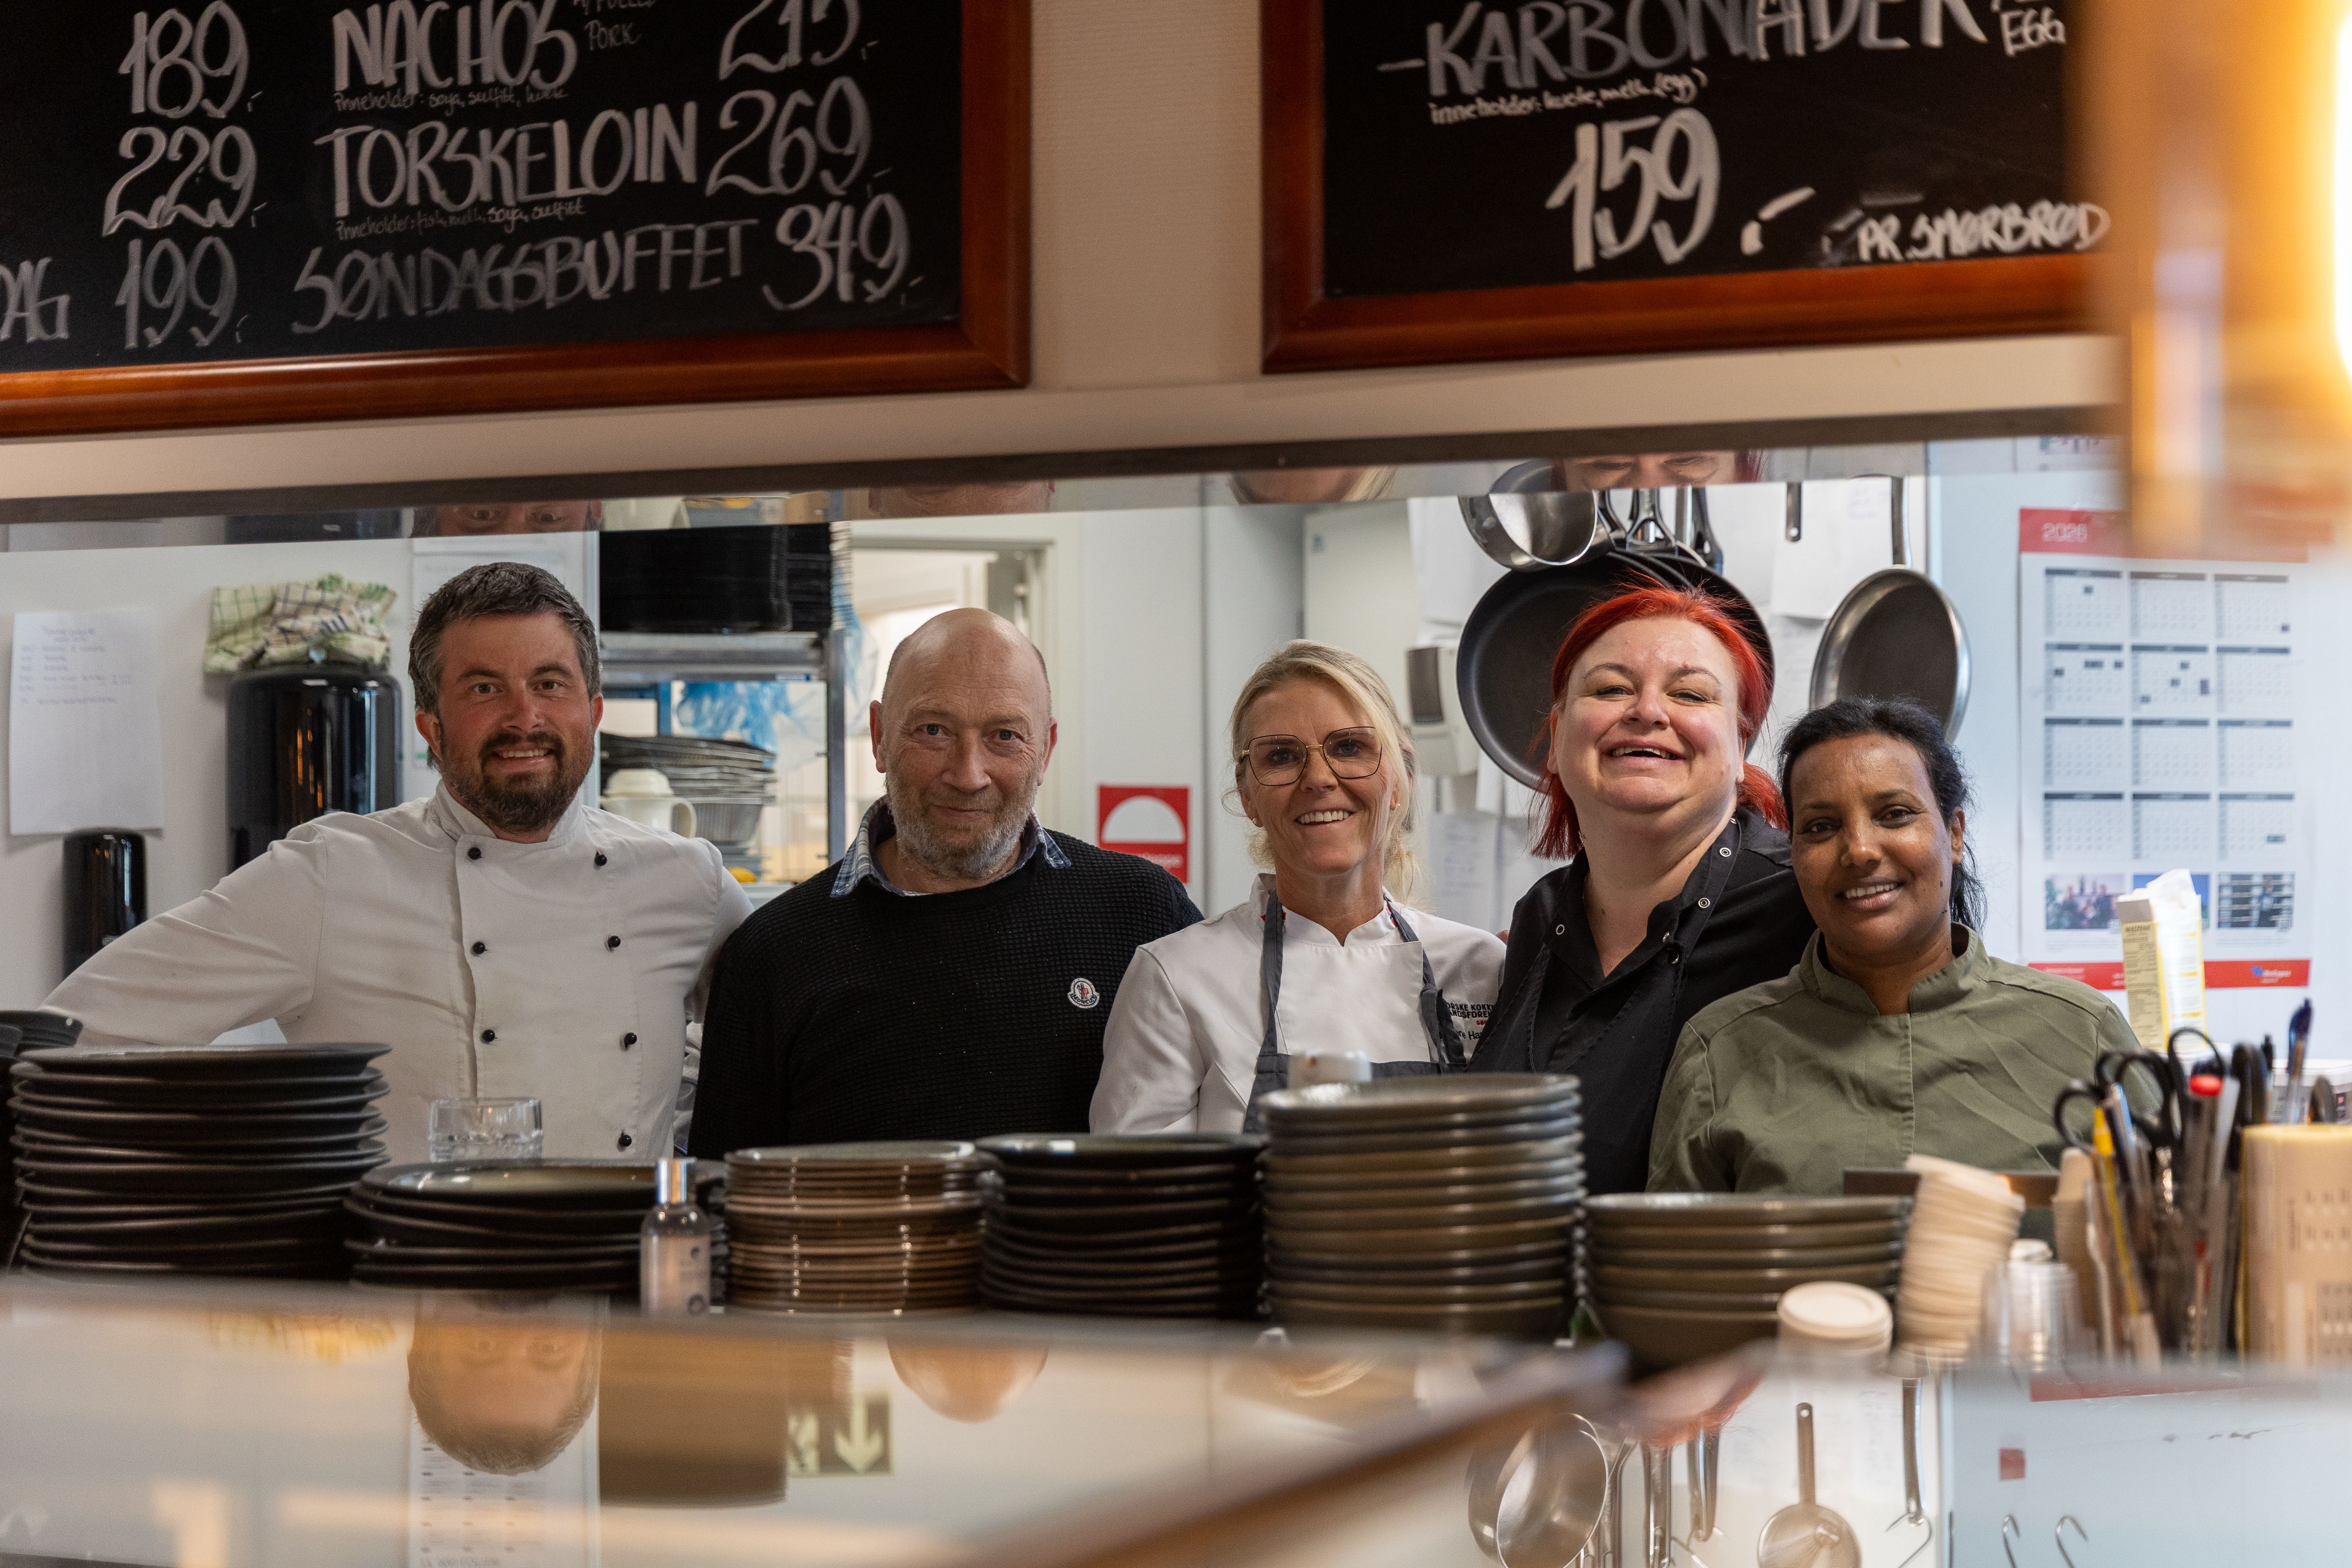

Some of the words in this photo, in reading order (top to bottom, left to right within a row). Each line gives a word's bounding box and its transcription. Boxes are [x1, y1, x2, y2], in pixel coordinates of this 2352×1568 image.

[332, 0, 578, 94] NACHOS
[584, 20, 641, 50] PORK
[314, 101, 697, 217] TORSKELOIN
[291, 218, 760, 334] SØNDAGSBUFFET
[1070, 993, 1097, 1004] MONCLER
[1468, 1031, 1482, 1040] Ha
